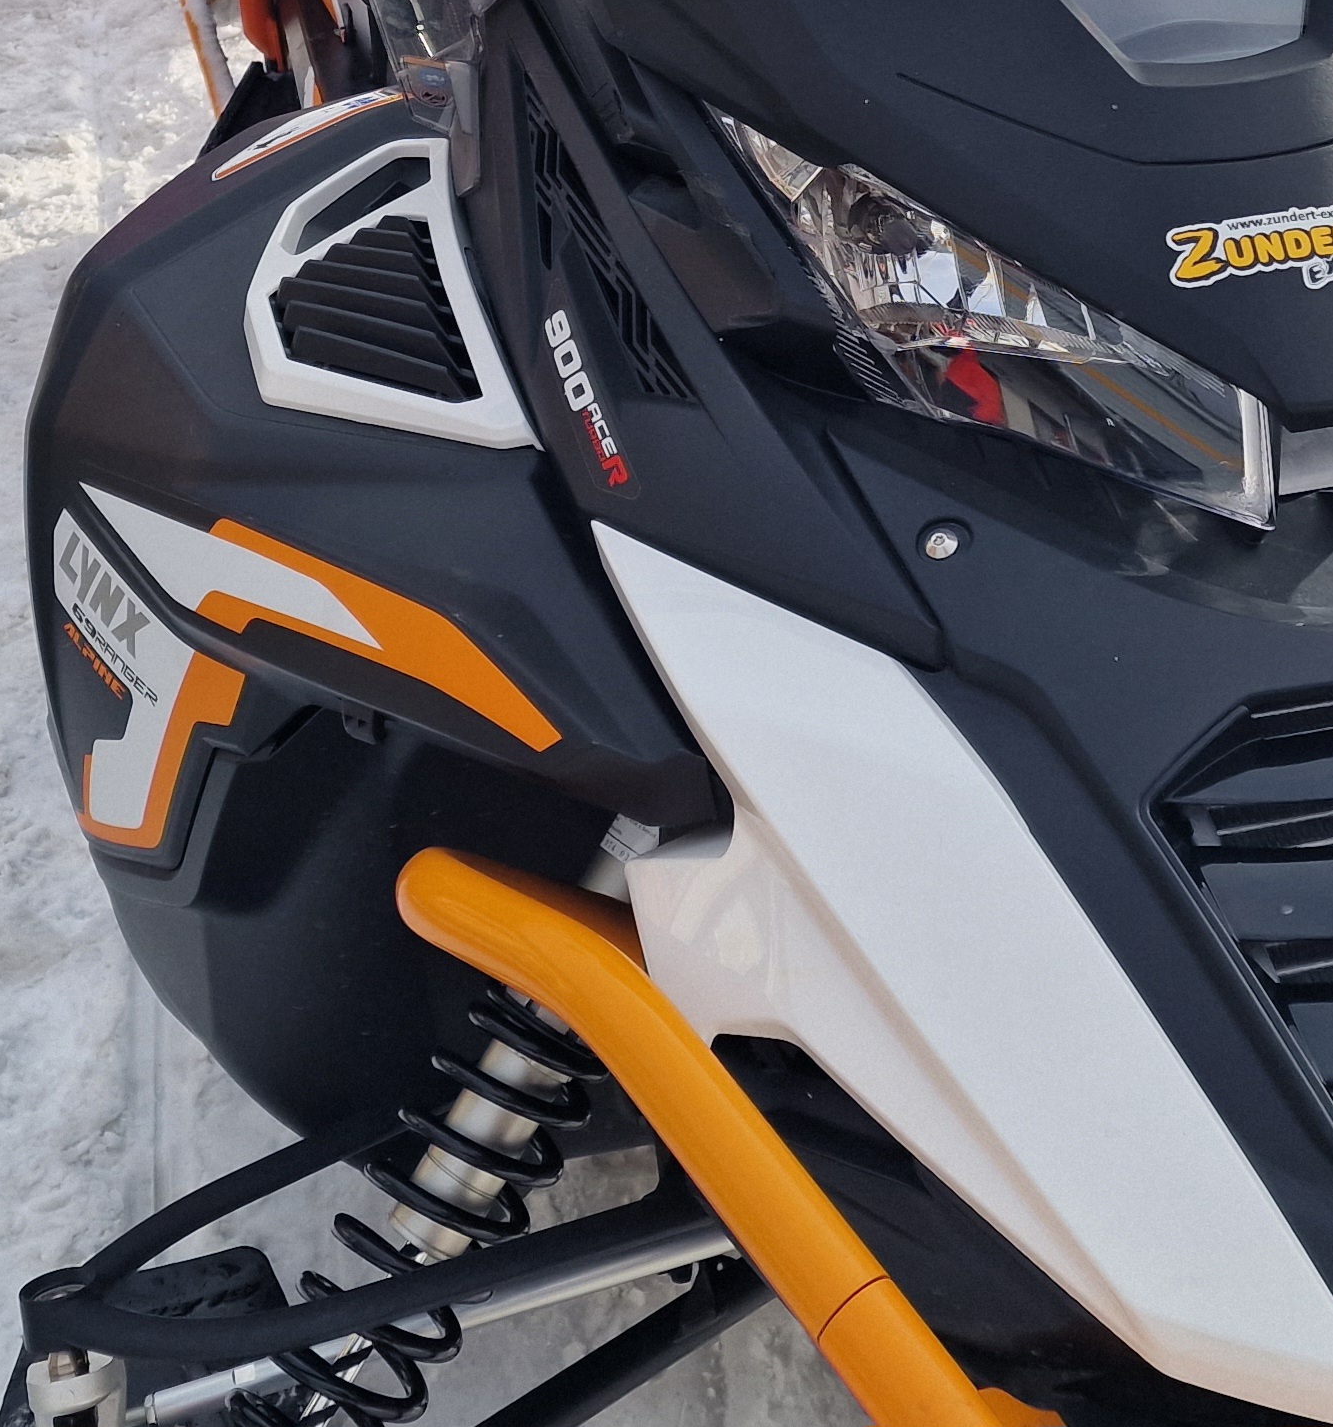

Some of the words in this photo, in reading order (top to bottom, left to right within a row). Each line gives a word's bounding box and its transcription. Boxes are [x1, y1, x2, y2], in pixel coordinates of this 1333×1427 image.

[544, 309, 595, 412] 900
[58, 531, 152, 660] LYNX
[63, 622, 127, 701] ALPINE
